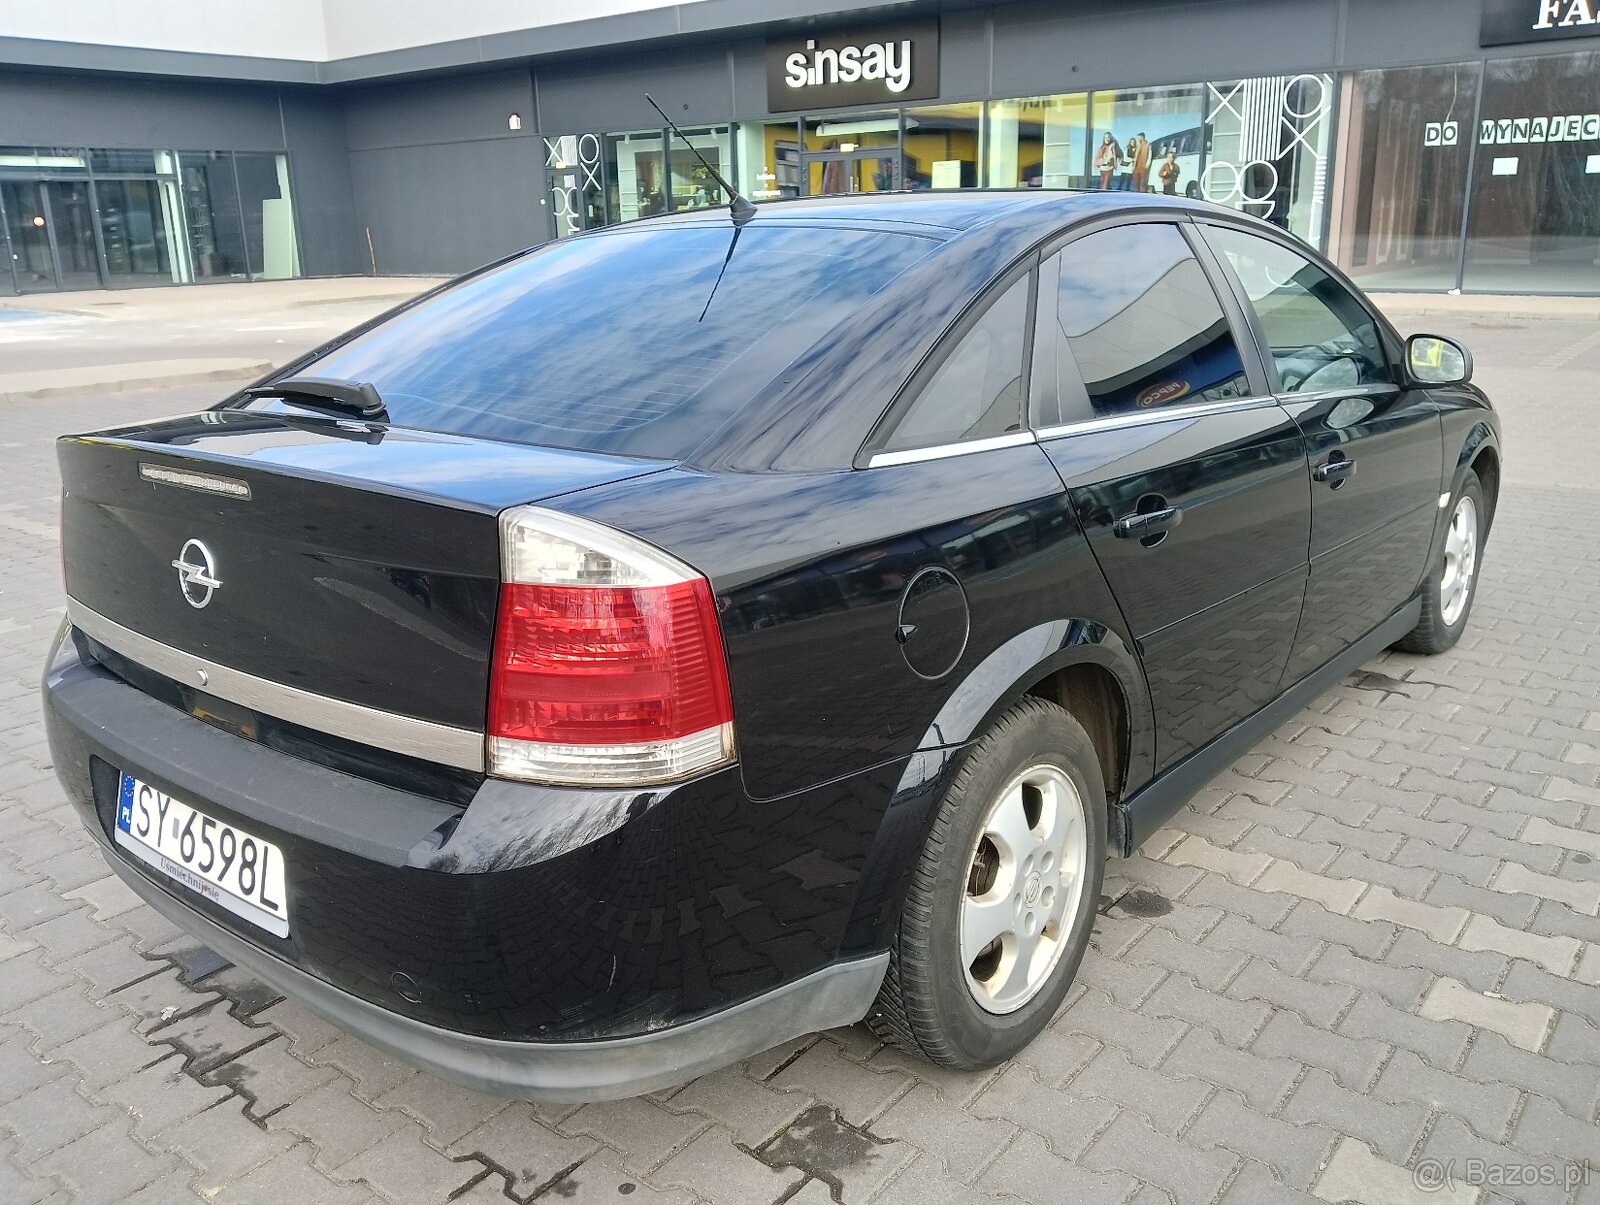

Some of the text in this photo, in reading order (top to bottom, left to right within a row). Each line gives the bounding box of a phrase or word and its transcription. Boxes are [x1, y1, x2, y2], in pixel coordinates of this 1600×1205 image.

[1532, 0, 1600, 29] FA
[785, 40, 911, 93] sinsay
[1426, 126, 1457, 142] DO
[122, 806, 131, 824] PL
[136, 784, 279, 911] SY 6598L
